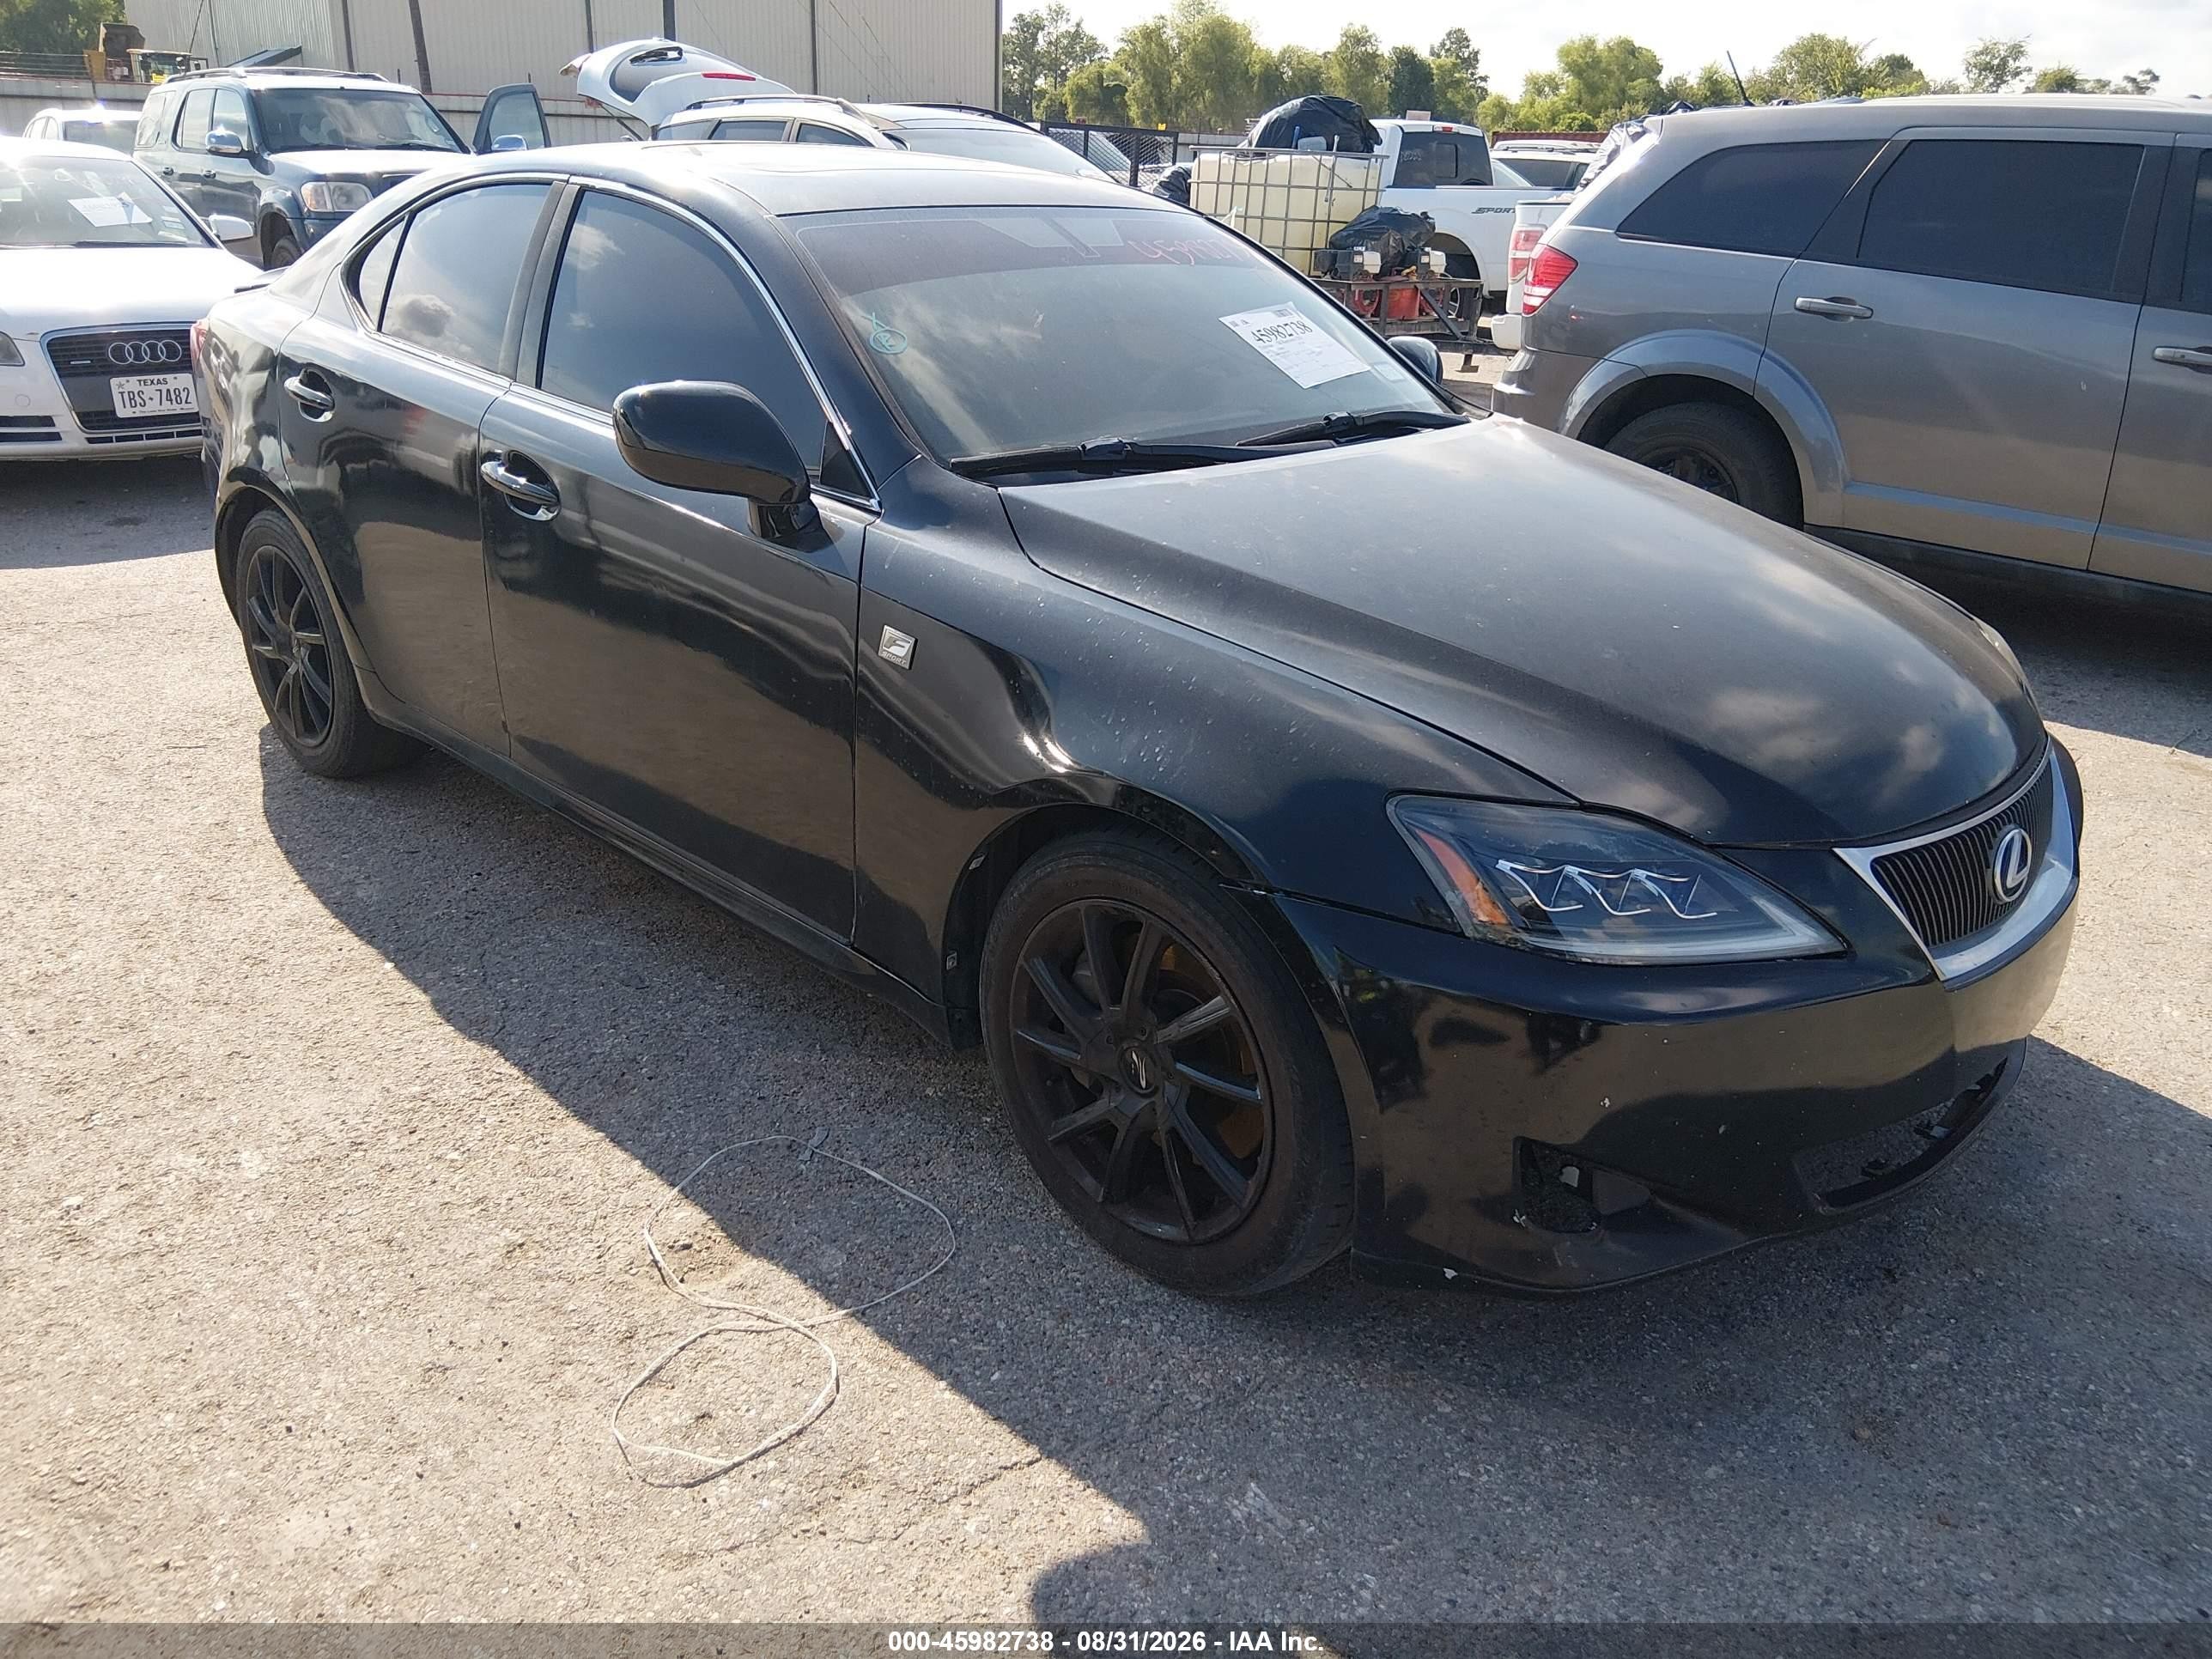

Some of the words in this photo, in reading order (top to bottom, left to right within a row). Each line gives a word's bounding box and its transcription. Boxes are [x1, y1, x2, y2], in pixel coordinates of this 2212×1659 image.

[1251, 320, 1313, 343] 45982738
[137, 378, 168, 386] TEXAS
[881, 650, 907, 665] SPORT
